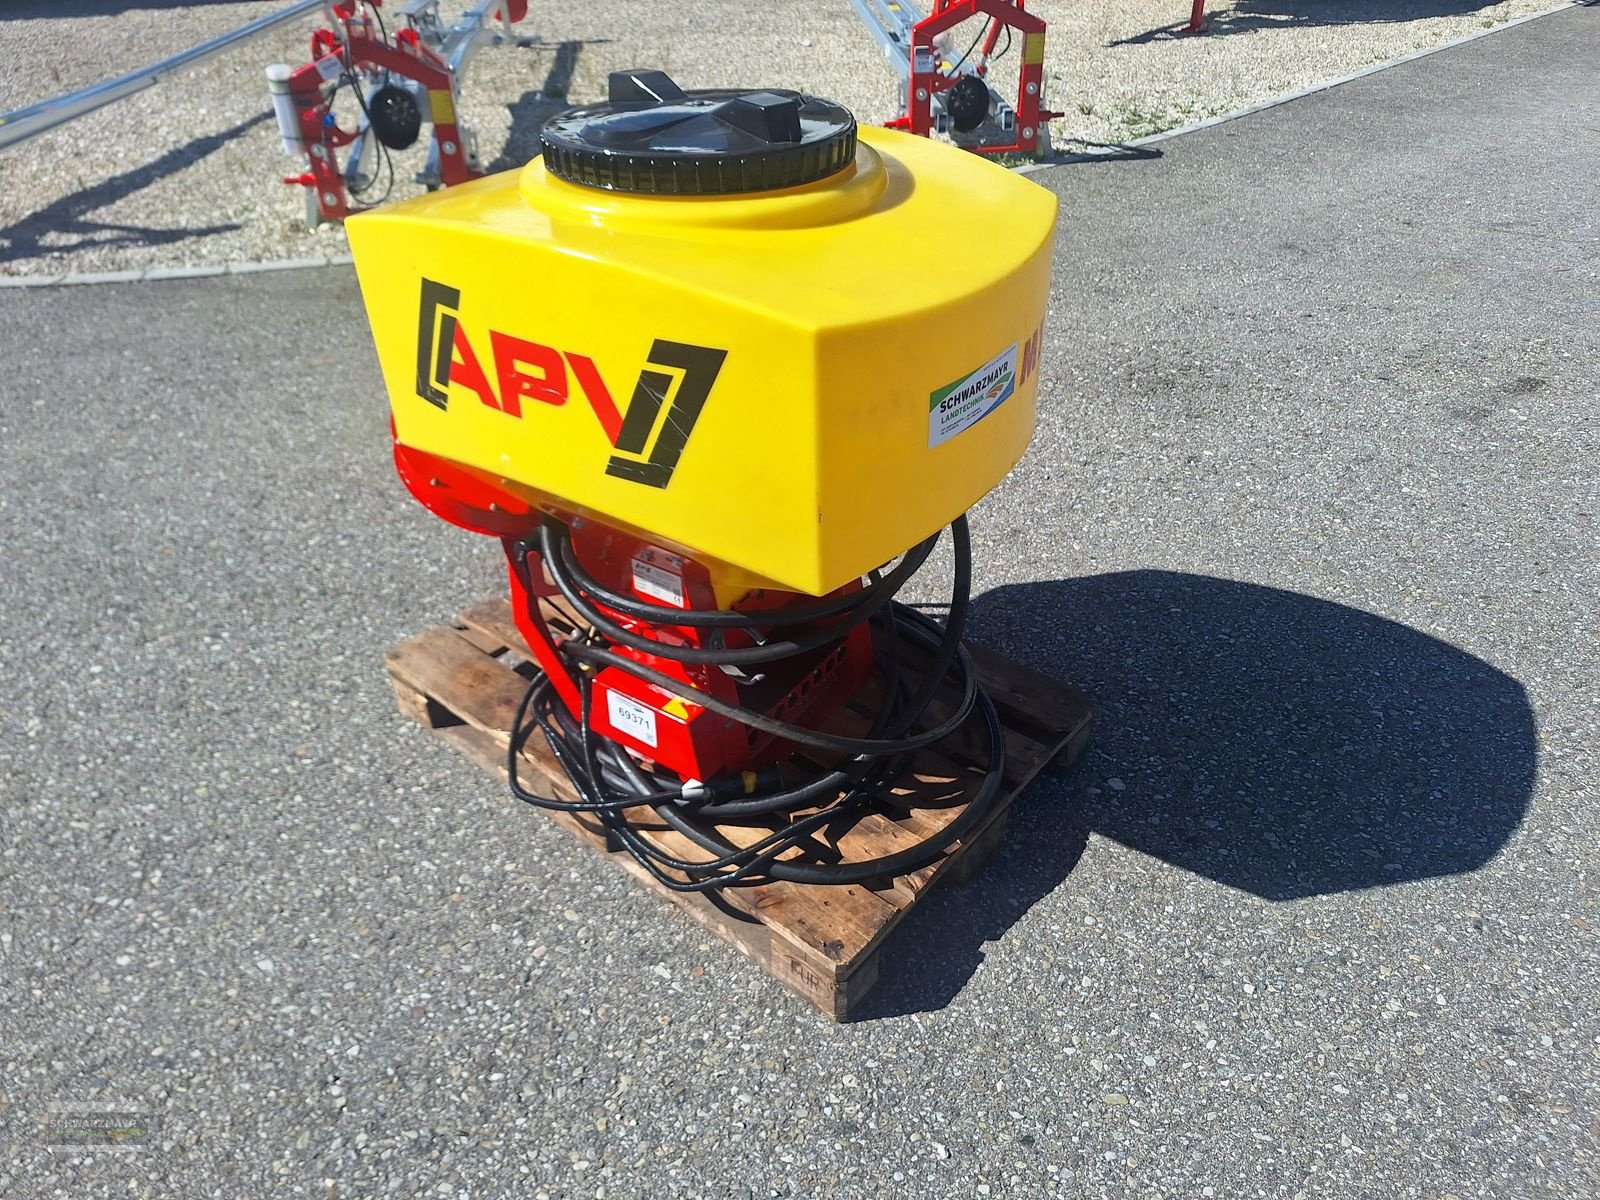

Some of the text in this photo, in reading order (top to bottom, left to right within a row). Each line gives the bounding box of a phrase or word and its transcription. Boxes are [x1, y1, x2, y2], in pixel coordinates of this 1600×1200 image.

[939, 360, 1009, 414] SCHWARZMAYR
[940, 392, 985, 425] LANDTECHNIK
[618, 707, 650, 730] 69371
